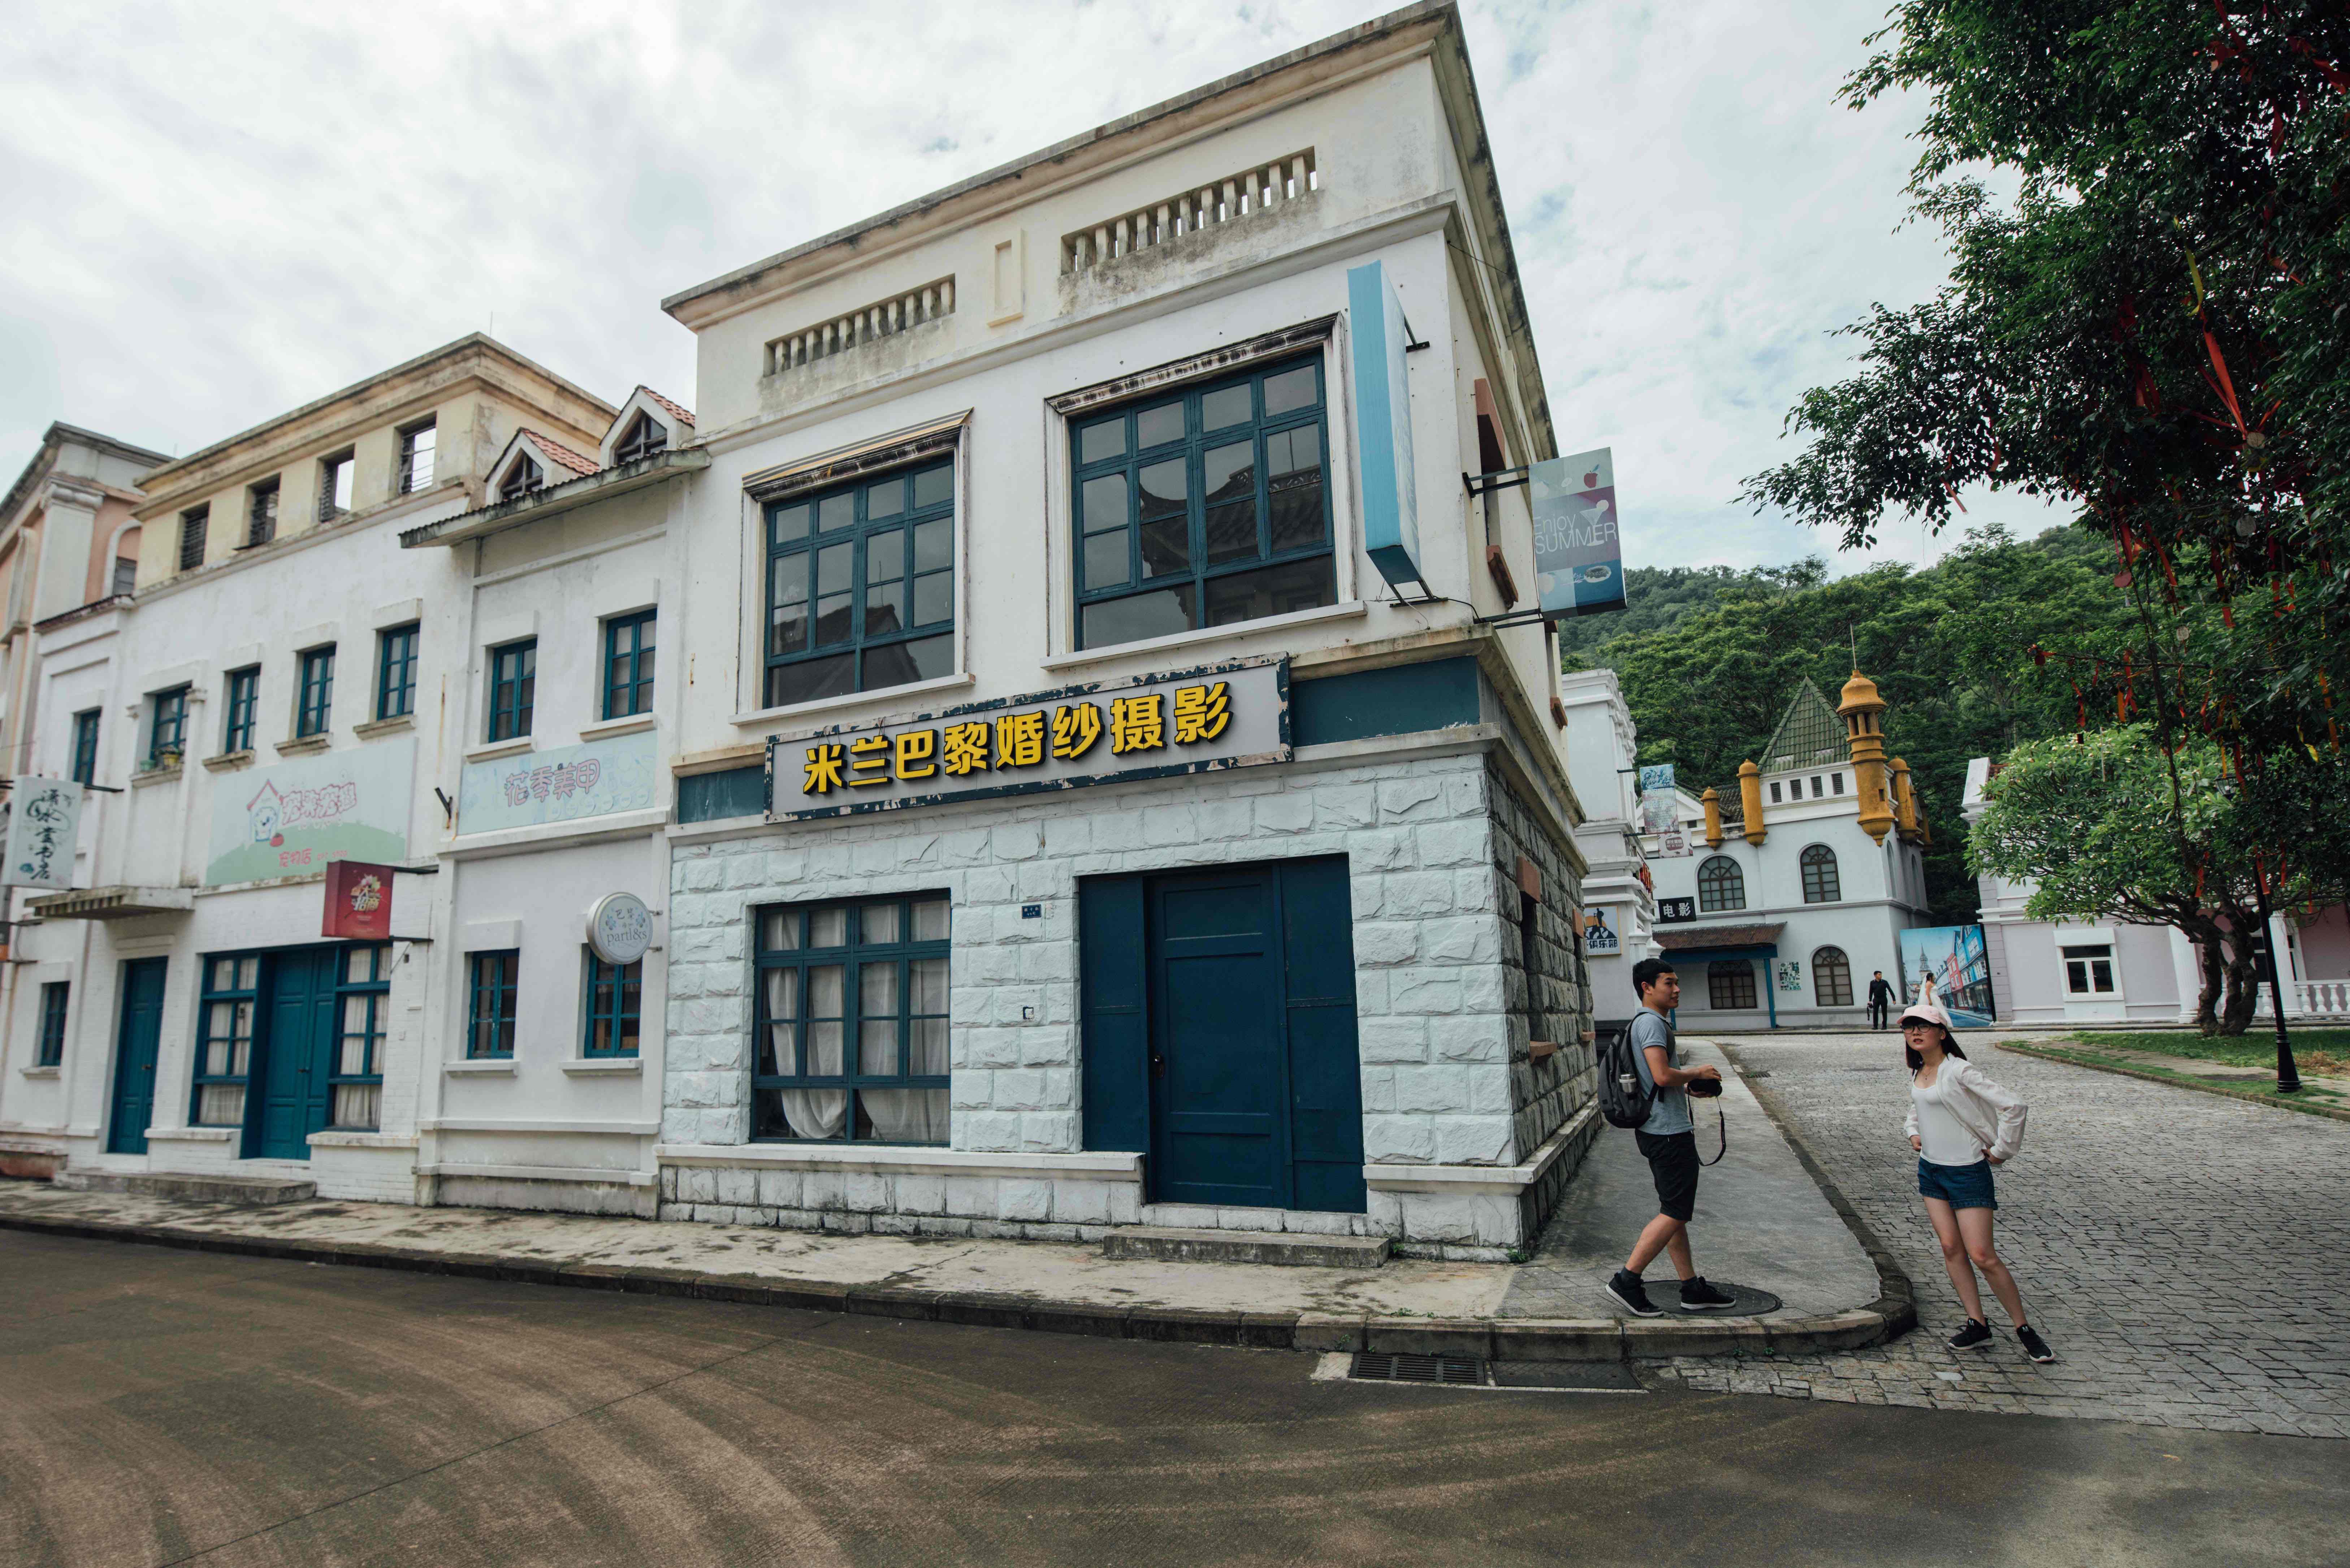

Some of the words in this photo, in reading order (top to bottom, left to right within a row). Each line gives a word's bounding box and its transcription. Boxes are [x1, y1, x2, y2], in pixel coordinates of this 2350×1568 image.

[1534, 513, 1576, 536] Enjoy
[1535, 522, 1617, 554] SUMMER
[803, 681, 1233, 794] 米兰巴黎婚纱摄影
[505, 759, 600, 807] 花季美甲
[279, 848, 312, 867] 宠物店
[1663, 902, 1691, 918] 电影
[1587, 939, 1618, 949] 俱乐部
